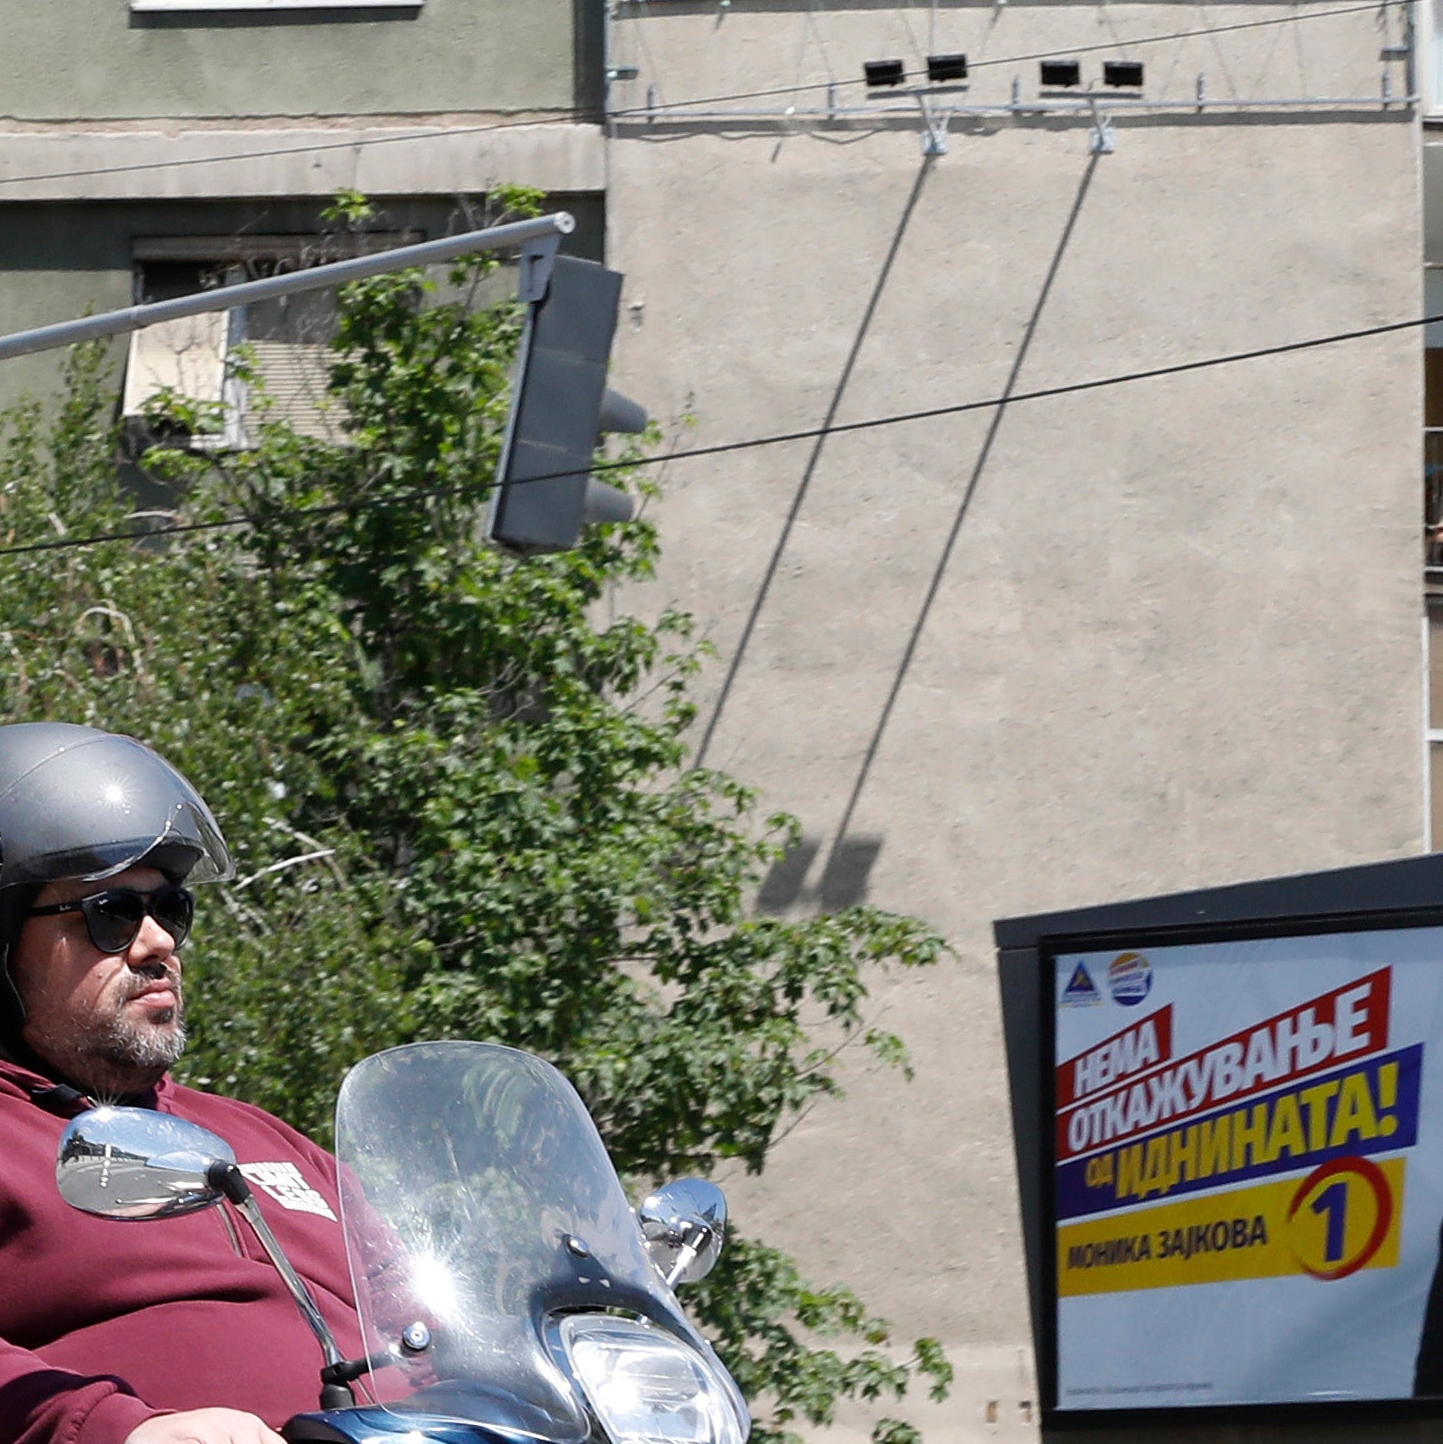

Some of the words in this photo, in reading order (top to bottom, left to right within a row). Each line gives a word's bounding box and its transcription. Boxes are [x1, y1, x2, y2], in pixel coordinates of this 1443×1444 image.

[1068, 981, 1372, 1152] ОТКАЖУВАЊЕ
[1073, 1018, 1159, 1099] НЕМА
[1116, 1062, 1399, 1201] ИДНИНАТА!
[1067, 1237, 1152, 1271] МОНИКА
[1157, 1214, 1268, 1263] ЗАЈКОВА
[1311, 1182, 1348, 1263] 1
